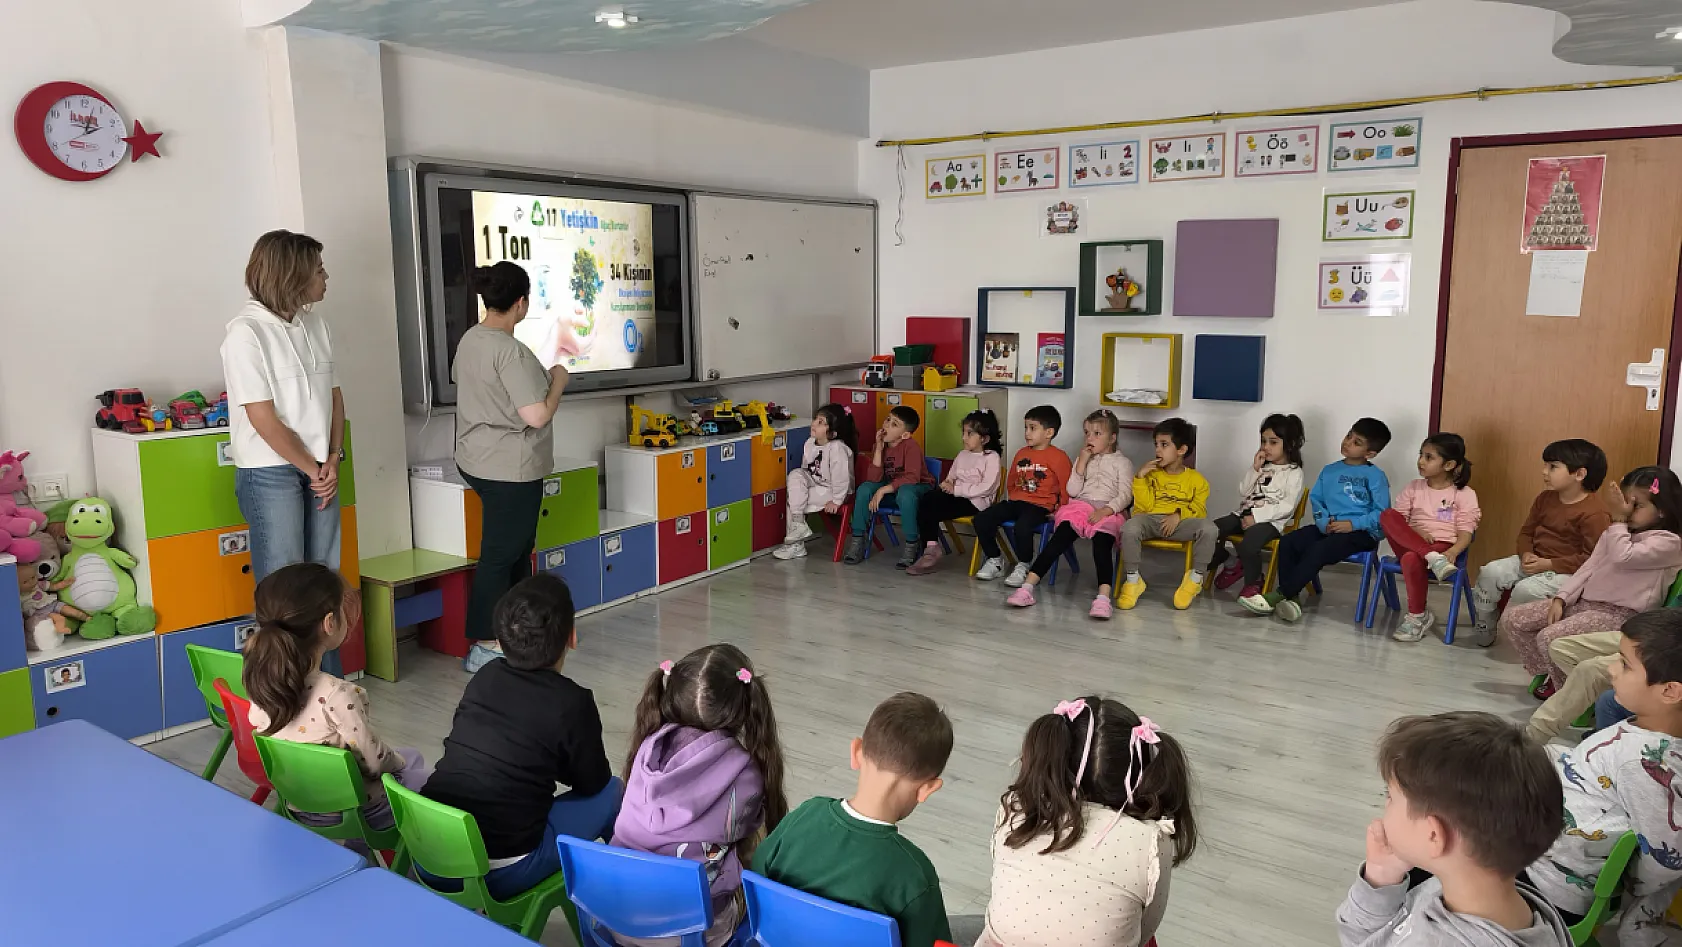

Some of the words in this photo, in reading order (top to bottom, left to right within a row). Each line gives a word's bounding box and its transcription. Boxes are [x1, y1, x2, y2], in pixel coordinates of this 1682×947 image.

[1362, 125, 1387, 139] Oo
[1266, 133, 1288, 150] Öö
[945, 160, 963, 173] Aa
[1016, 153, 1035, 169] Ee
[1354, 198, 1379, 213] Uu
[546, 207, 557, 227] 17
[560, 209, 599, 234] Yetişkin
[483, 224, 492, 261] 1
[498, 225, 532, 261] Ton
[610, 263, 621, 281] 34
[622, 263, 653, 286] Kişinin
[1350, 265, 1372, 285] Üü
